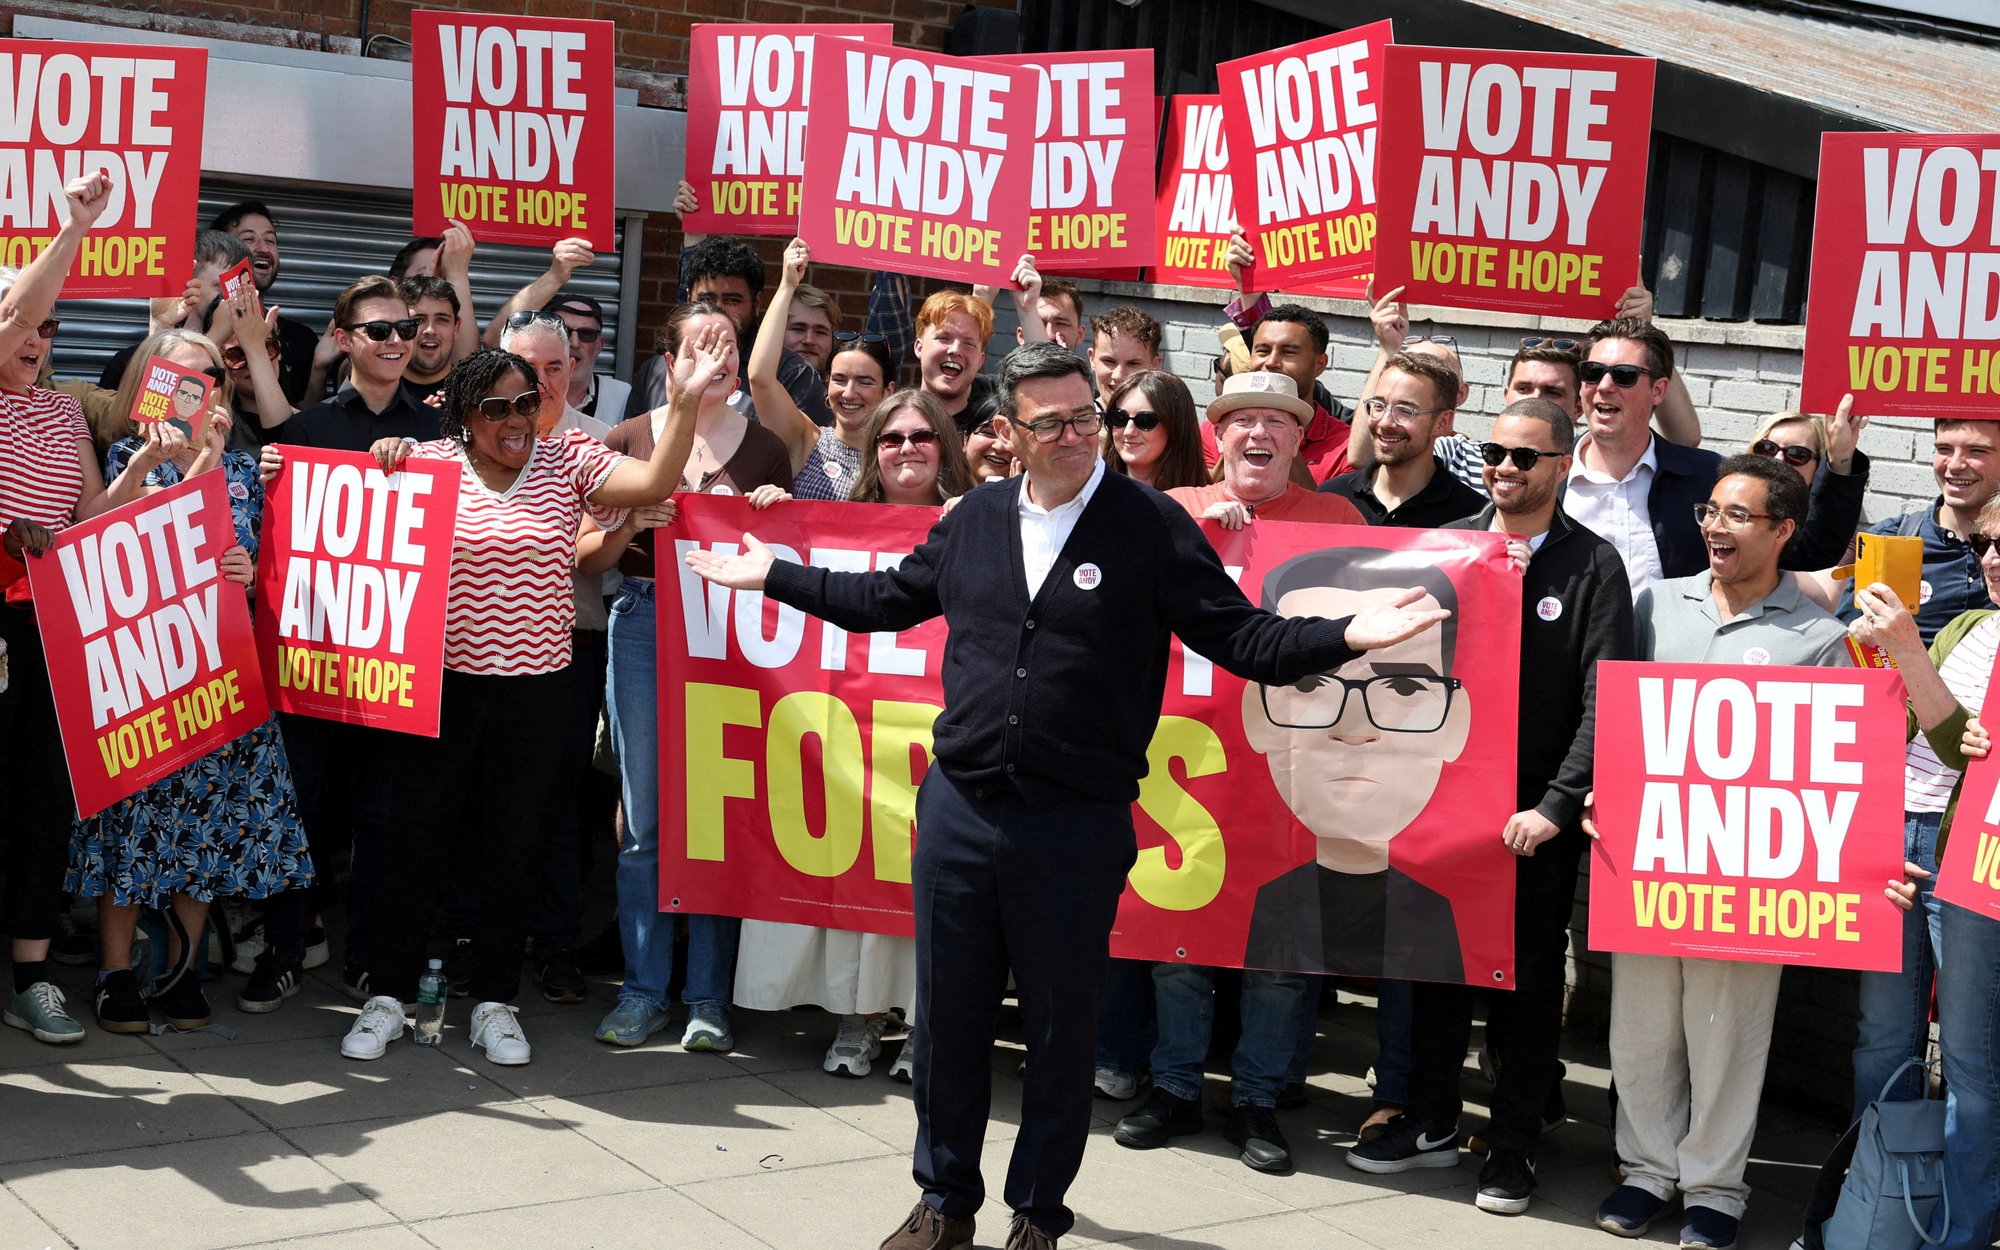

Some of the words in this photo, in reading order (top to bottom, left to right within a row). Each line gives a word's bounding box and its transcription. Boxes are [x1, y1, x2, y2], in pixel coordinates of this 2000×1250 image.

[0, 52, 176, 145] VOTE
[438, 24, 587, 111] VOTE
[1240, 39, 1377, 148] VOTE
[846, 50, 1011, 151] VOTE
[1419, 61, 1617, 161] VOTE
[440, 107, 585, 185] ANDY
[836, 132, 1005, 222] ANDY
[1255, 126, 1377, 226] ANDY
[0, 149, 170, 229] ANDY
[440, 182, 508, 222] VOTE
[517, 188, 587, 229] HOPE
[711, 181, 779, 216] VOTE
[1411, 155, 1608, 246] ANDY
[81, 236, 166, 276] HOPE
[834, 207, 912, 254] VOTE
[921, 220, 1002, 267] HOPE
[1051, 213, 1128, 250] HOPE
[1165, 236, 1210, 269] VOTE
[1260, 223, 1323, 269] VOTE
[1326, 212, 1377, 258] HOP
[1410, 240, 1498, 288] VOTE
[1507, 248, 1603, 296] HOPE
[1849, 250, 2000, 340] AND
[143, 389, 170, 410] VOTE
[146, 377, 175, 396] ANDY
[151, 365, 179, 386] VOTE
[1848, 345, 1950, 393] VOTE
[138, 401, 167, 421] HOPE
[291, 461, 434, 566] VOTE
[57, 489, 217, 638] VOTE
[1079, 568, 1097, 577] VOTE
[1079, 577, 1097, 585] ANDY
[279, 556, 421, 654] ANDY
[1540, 609, 1556, 617] ANDY
[1542, 600, 1558, 610] VOTE
[83, 583, 223, 730] ANDY
[278, 645, 341, 696] VOTE
[346, 658, 416, 708] HOPE
[1872, 653, 1883, 668] FOR
[97, 706, 173, 779] VOTE
[174, 669, 245, 740] HOPE
[1638, 677, 1864, 784] VOTE
[1632, 781, 1860, 883] ANDY
[1632, 880, 1736, 933] VOTE
[1749, 887, 1861, 942] HOPE
